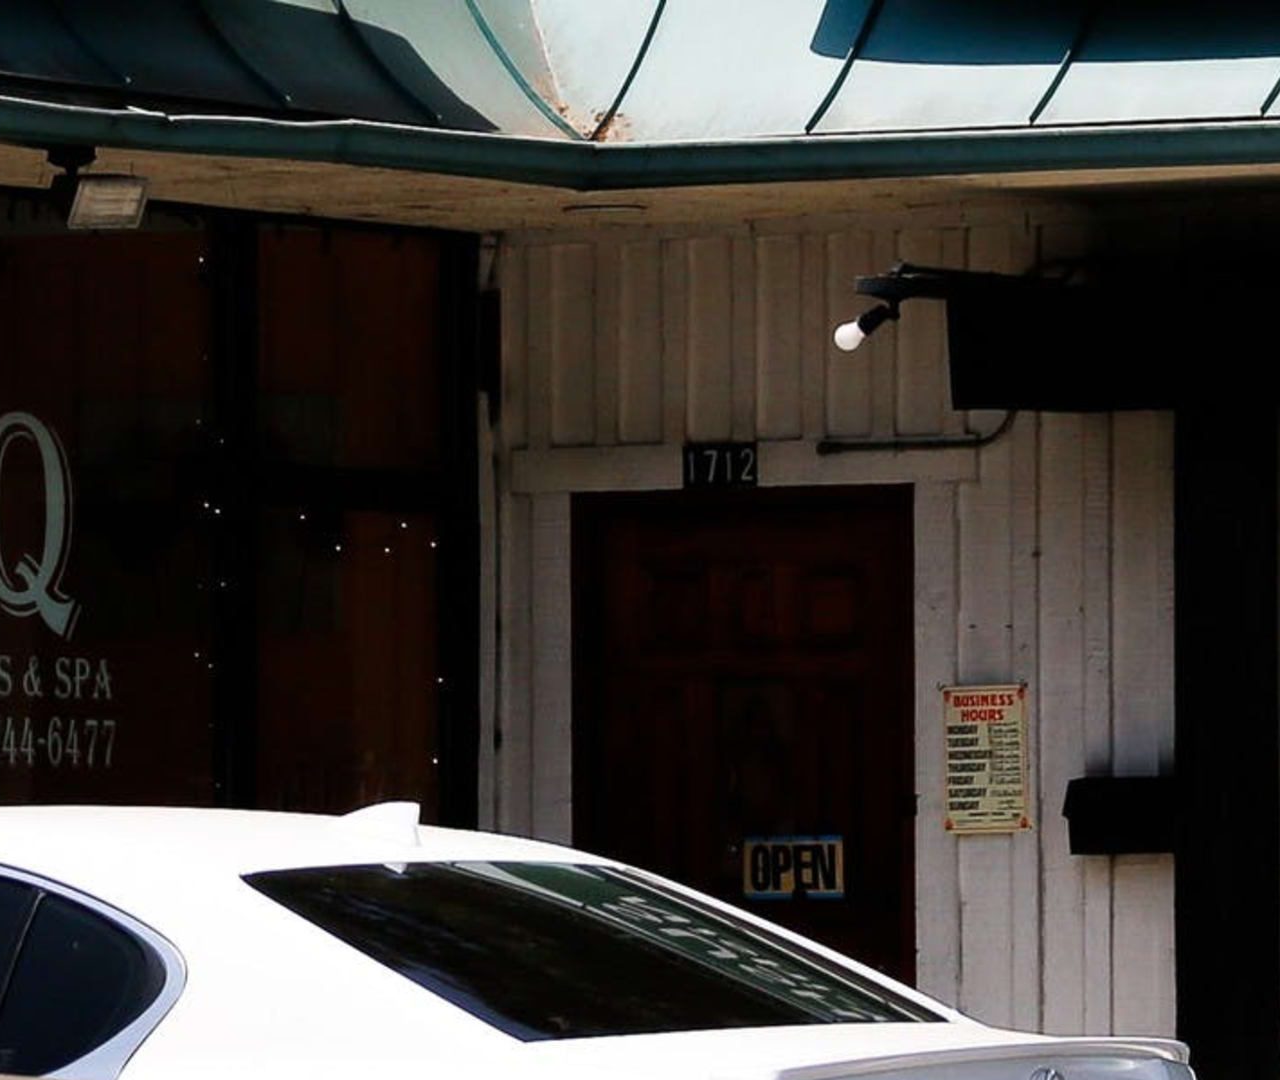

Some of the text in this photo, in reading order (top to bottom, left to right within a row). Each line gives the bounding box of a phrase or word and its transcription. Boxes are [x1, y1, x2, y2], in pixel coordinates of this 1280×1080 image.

[687, 447, 754, 484] 1712
[21, 654, 43, 697] &
[53, 656, 116, 700] SPA
[953, 694, 1015, 708] BUSINESS
[960, 708, 1004, 722] HOURS
[751, 844, 836, 892] OPEN
